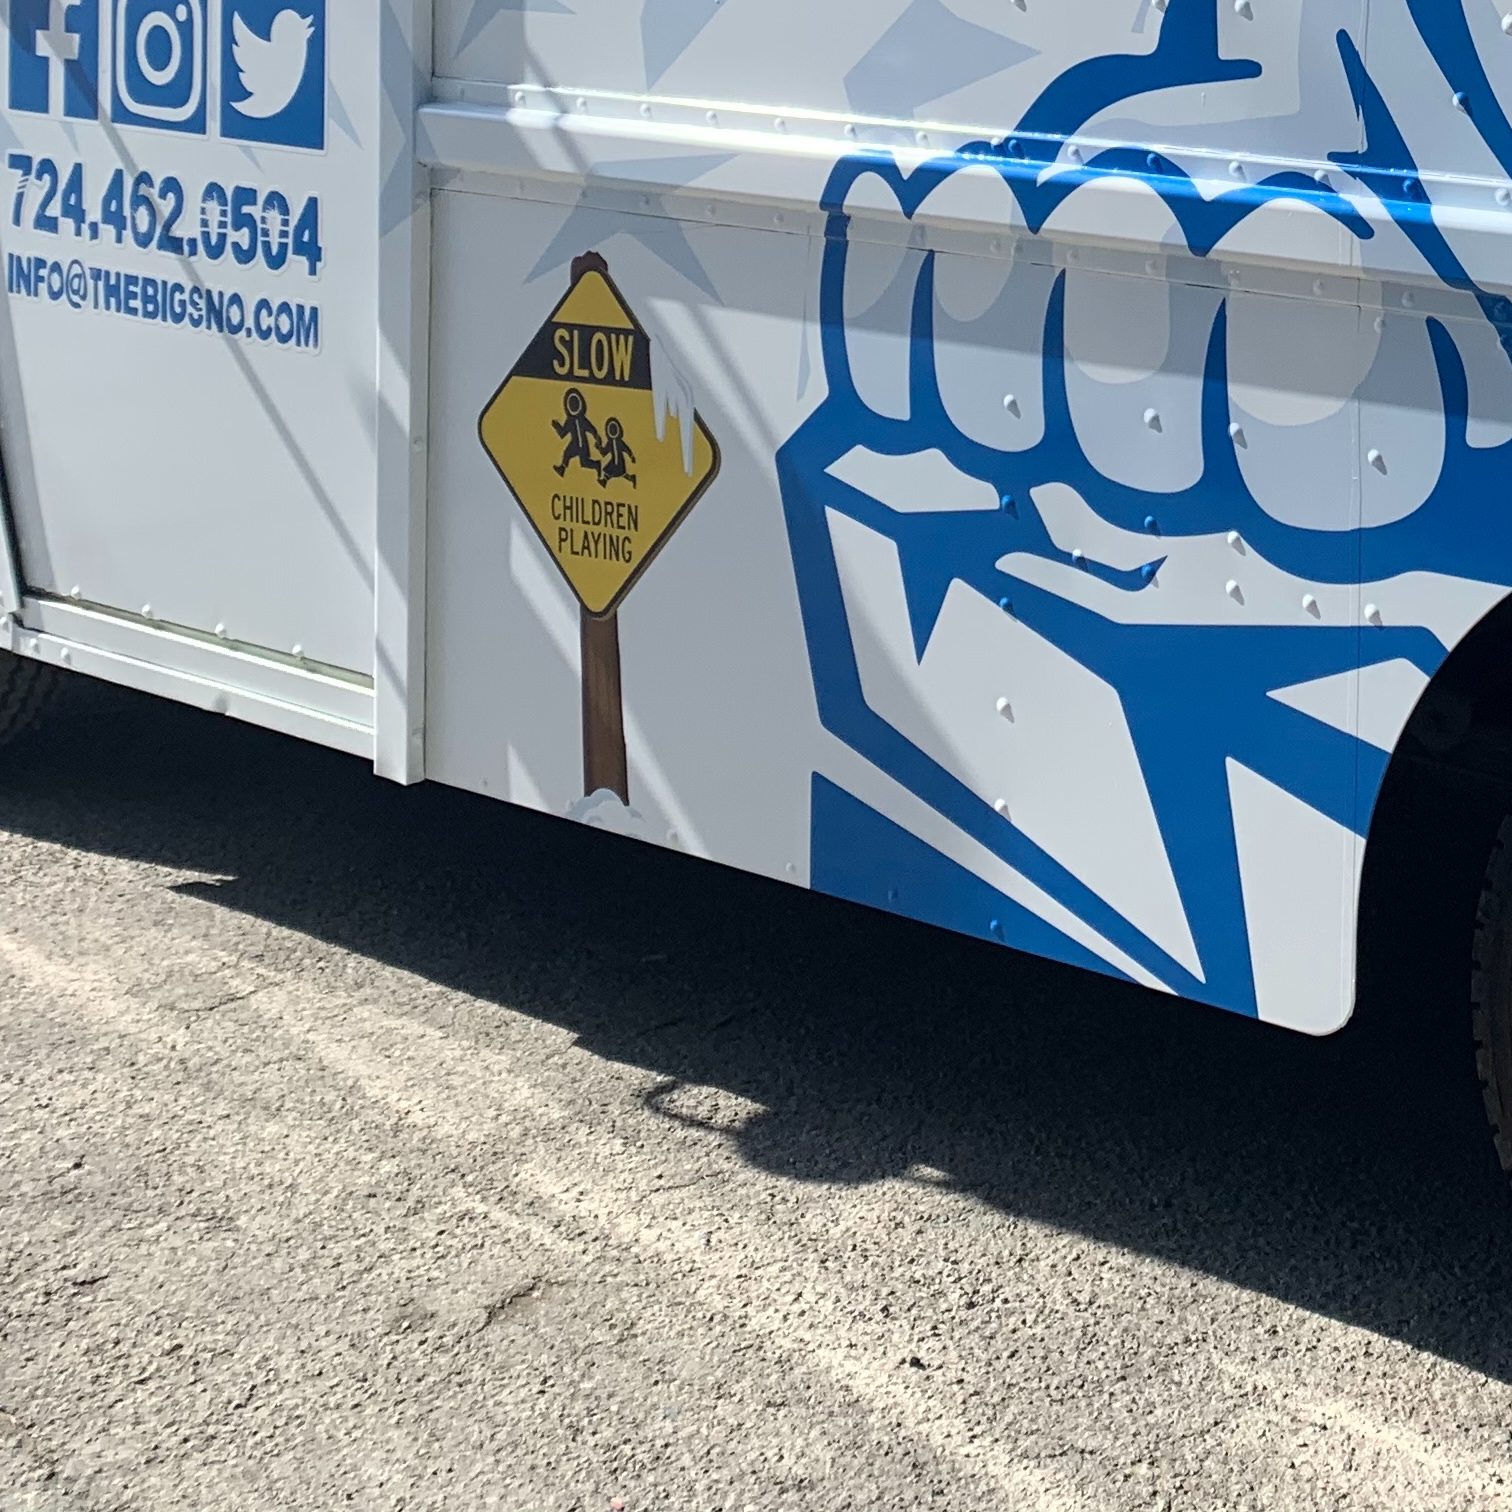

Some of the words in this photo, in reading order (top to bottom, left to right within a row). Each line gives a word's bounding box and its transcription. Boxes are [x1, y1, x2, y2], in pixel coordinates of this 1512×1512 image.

[8, 154, 322, 276] 724.462.0504
[8, 253, 318, 348] INFO@THEBIGSNO.COM
[553, 328, 633, 382] SLOW
[551, 494, 638, 532] CHILDREN
[558, 526, 632, 563] PLAYING
